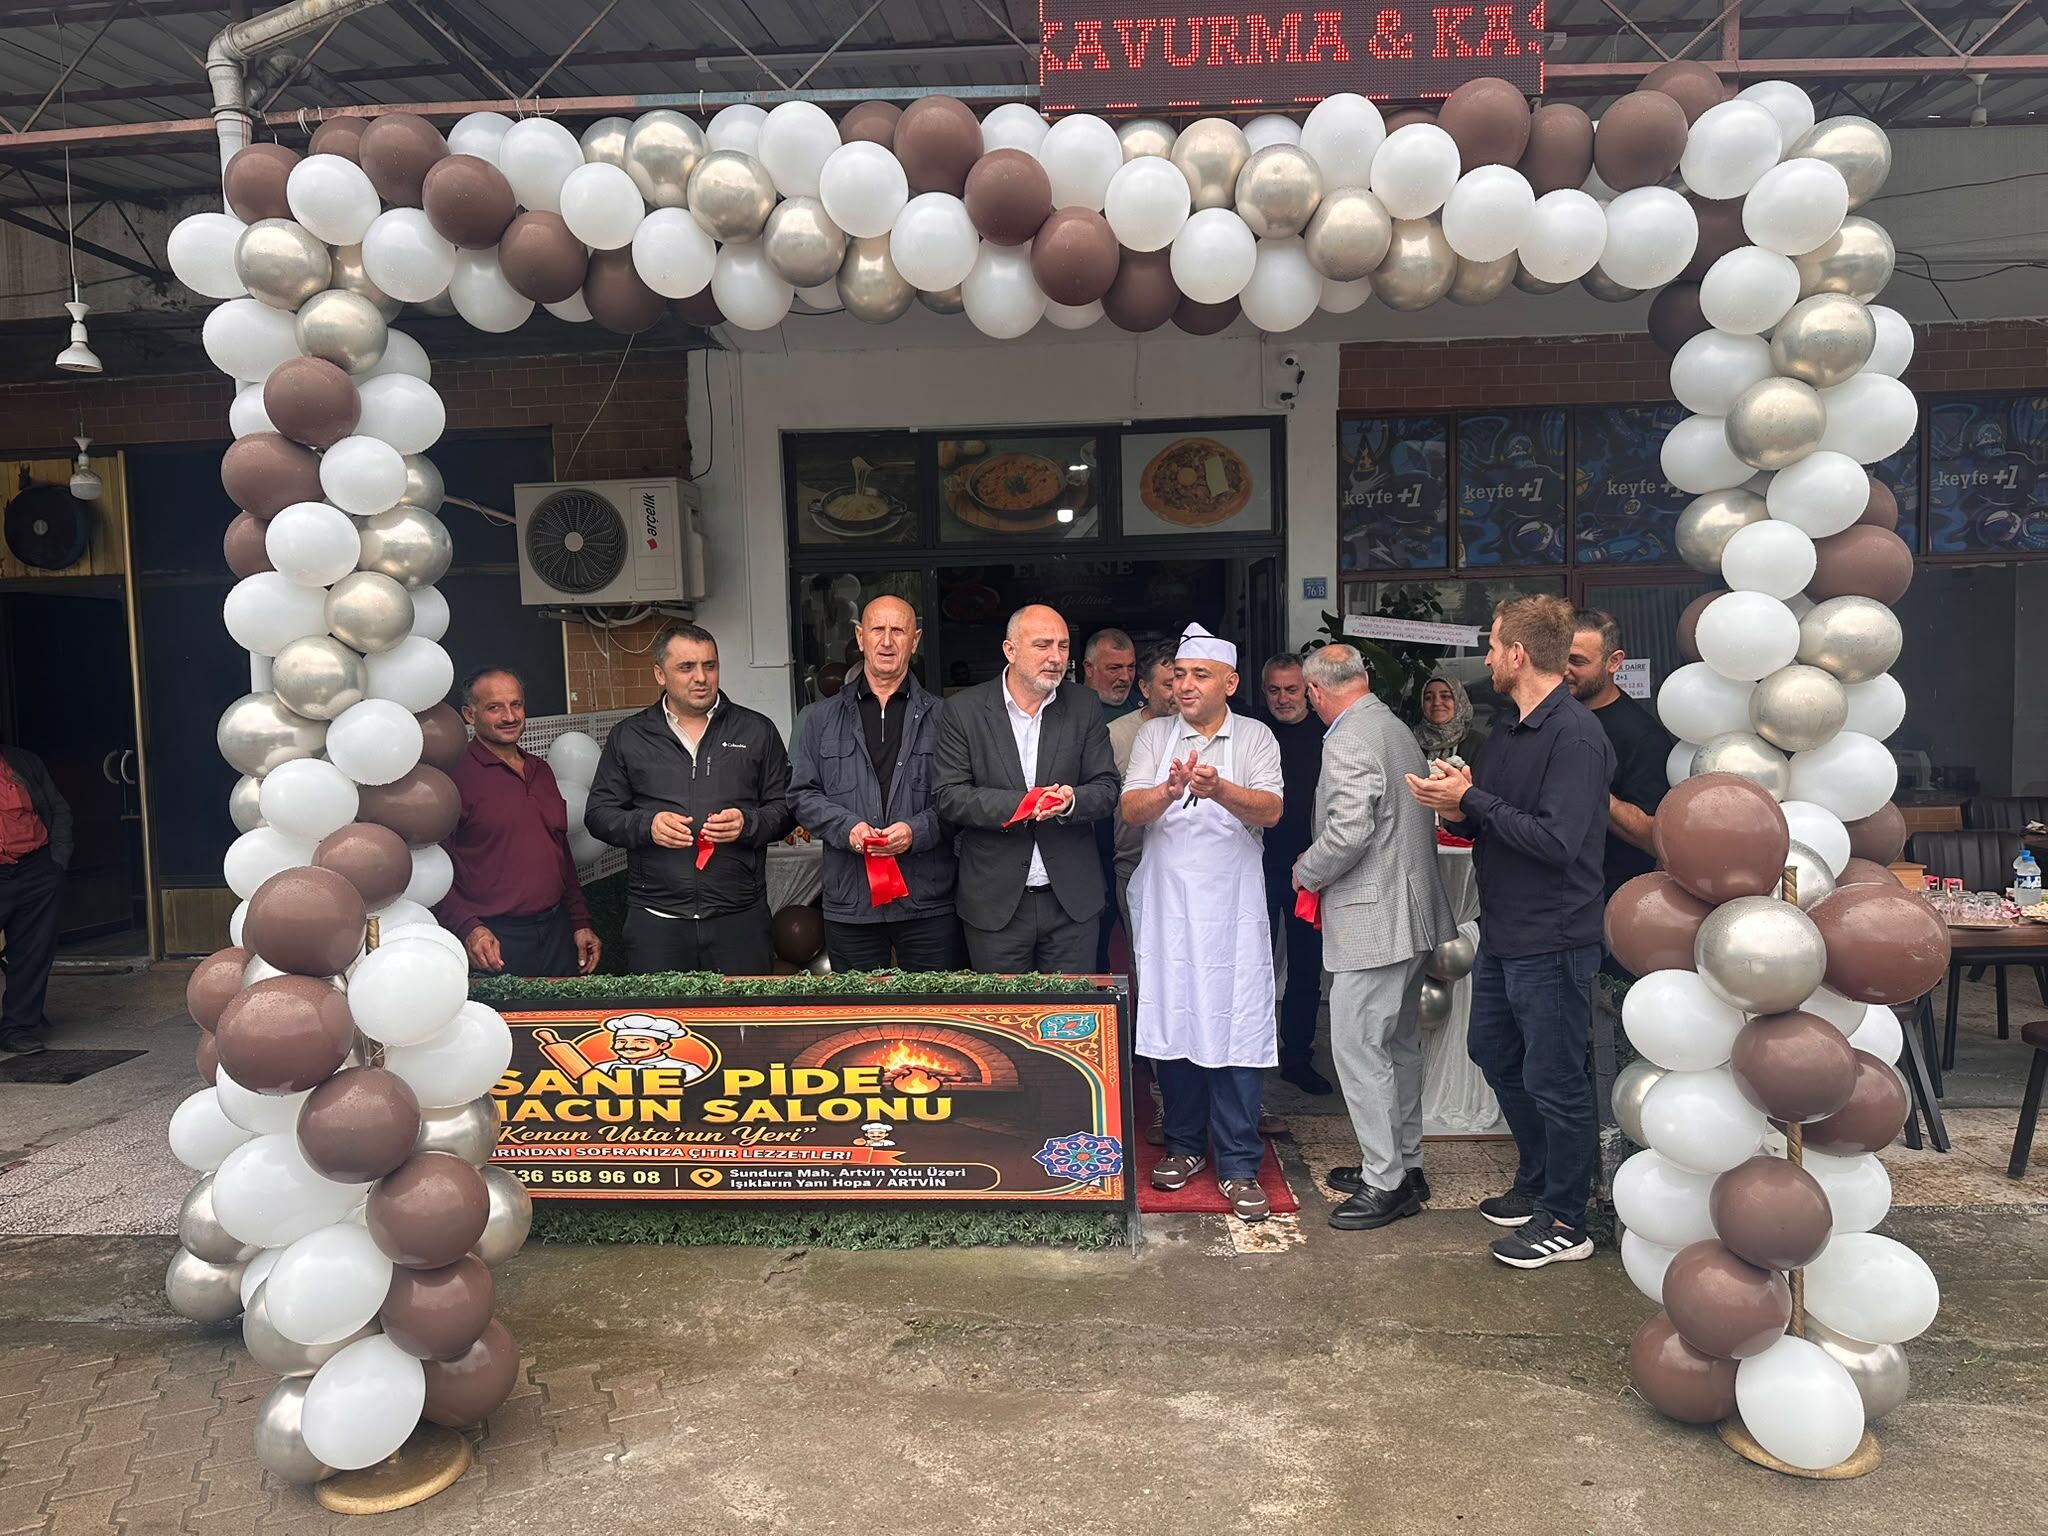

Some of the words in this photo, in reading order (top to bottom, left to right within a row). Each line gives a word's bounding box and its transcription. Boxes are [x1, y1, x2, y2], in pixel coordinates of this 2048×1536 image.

[1368, 8, 1413, 60] &
[1607, 479, 1657, 498] keyfe
[1938, 470, 1989, 489] keyfe
[1993, 465, 2019, 489] +1
[1344, 490, 1393, 508] keyfe
[1398, 483, 1423, 508] +1
[1463, 484, 1514, 502] keyfe
[1518, 478, 1544, 502] +1
[642, 492, 659, 537] arçelik
[722, 1062, 882, 1096] PİDE
[701, 1097, 952, 1123] SALONU
[497, 1125, 592, 1145] Kenan
[575, 1147, 685, 1158] SOFRANIZA
[688, 1148, 738, 1160] ÇITIR
[742, 1149, 853, 1161] LEZZETLER!
[507, 1169, 544, 1184] 36
[551, 1169, 592, 1184] 568
[598, 1170, 626, 1184] 96
[633, 1170, 661, 1184] 08
[729, 1168, 793, 1178] Sundura
[797, 1168, 836, 1178] Mah.
[838, 1167, 886, 1178] Artvin
[889, 1167, 922, 1178] Yolu
[926, 1166, 967, 1177] Üzeri
[796, 1178, 829, 1188] Yanı
[832, 1178, 872, 1190] Hopa
[887, 1176, 947, 1188] ARTVİN
